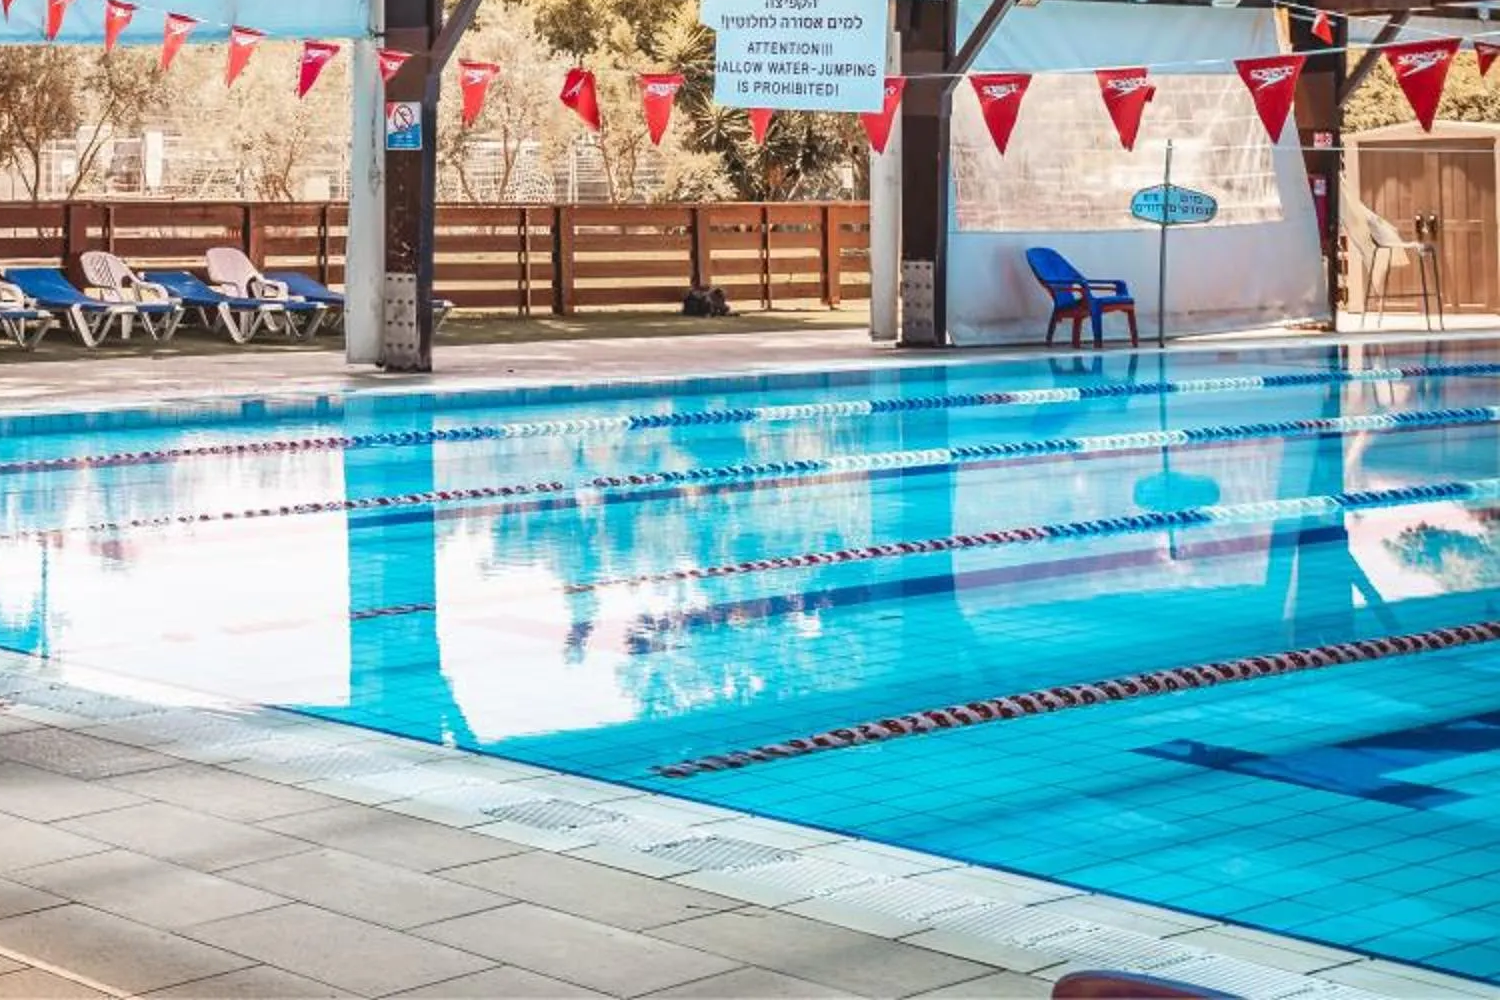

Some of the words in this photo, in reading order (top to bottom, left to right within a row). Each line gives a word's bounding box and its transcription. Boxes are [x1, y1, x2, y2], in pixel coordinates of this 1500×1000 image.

[780, 17, 824, 29] אסורה
[827, 15, 863, 29] למים
[737, 80, 749, 93] IS
[753, 81, 839, 96] PROHIBITED!
